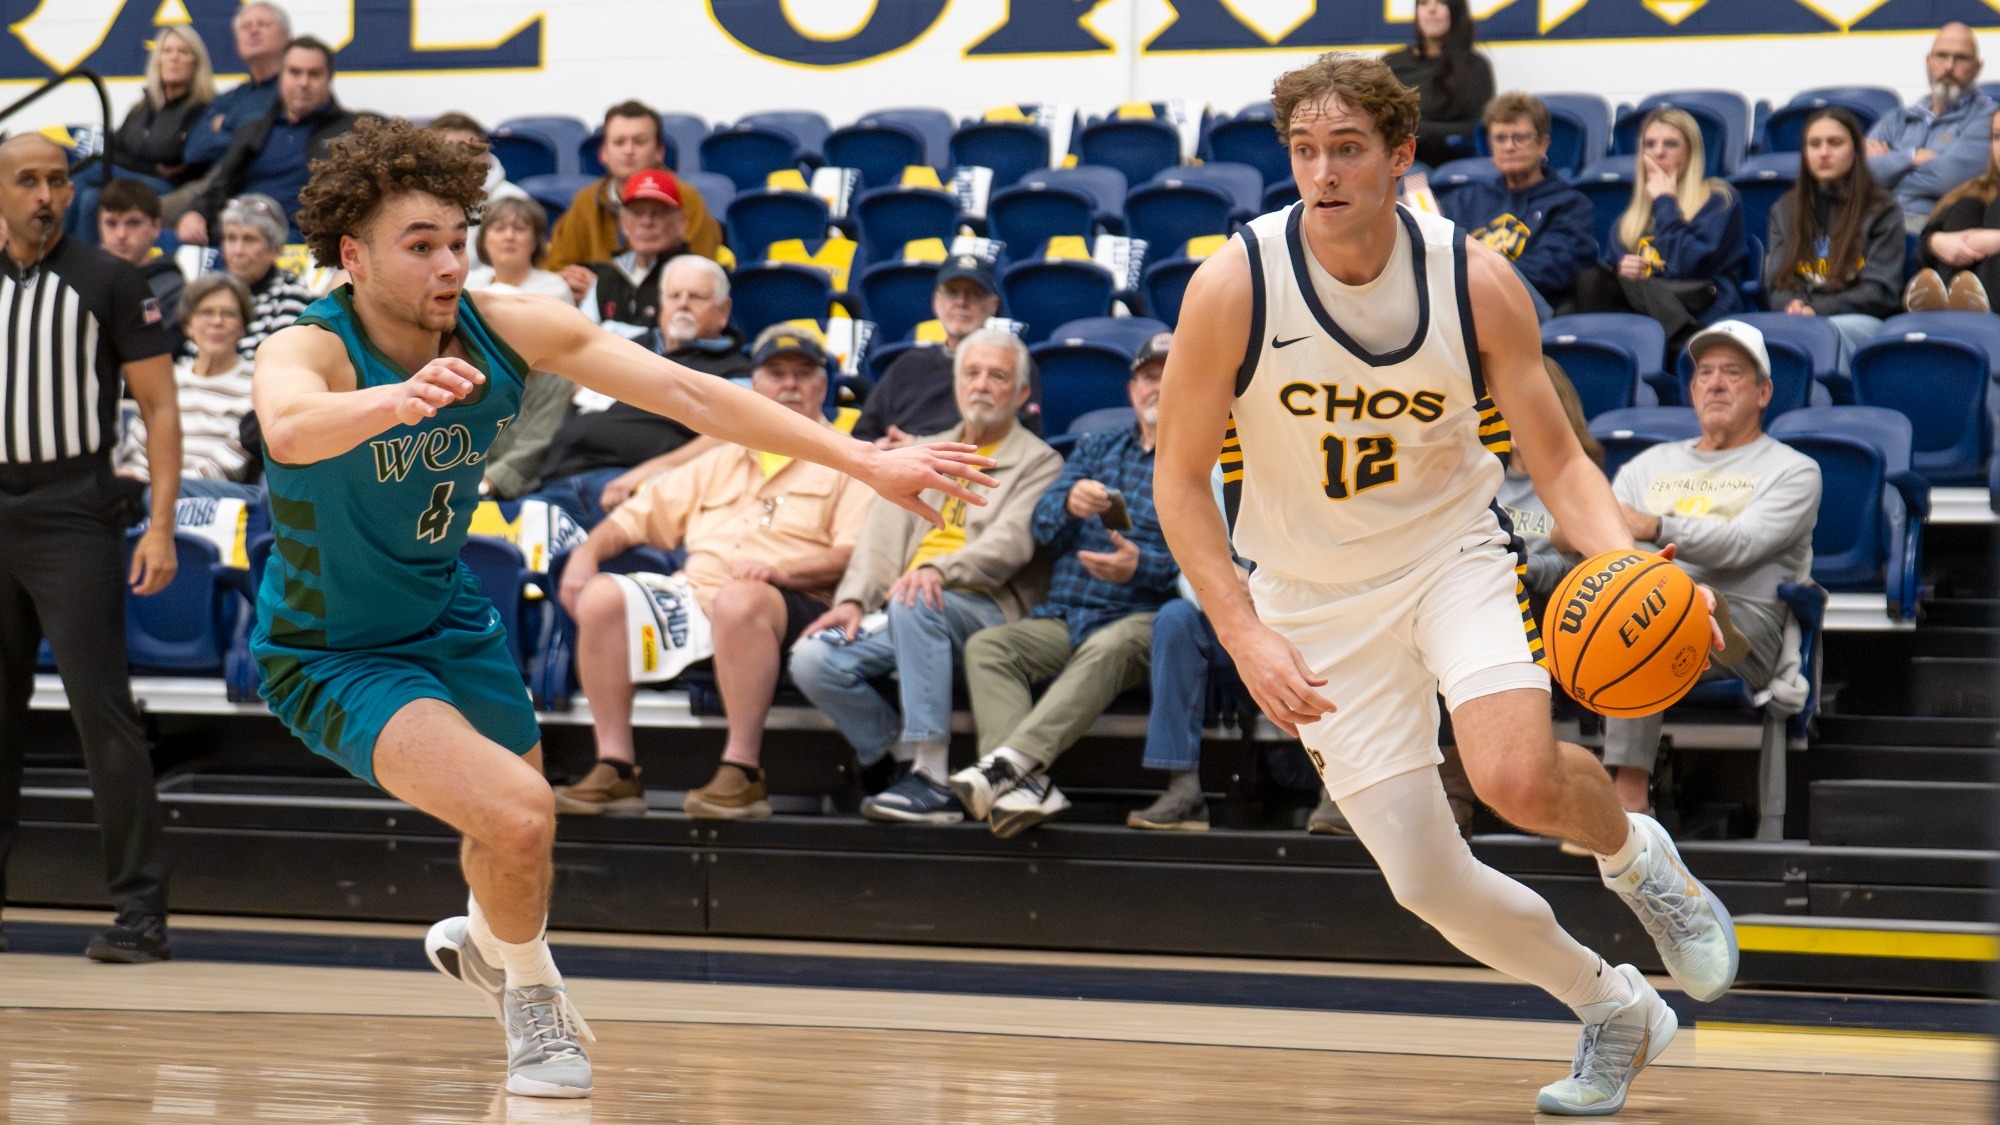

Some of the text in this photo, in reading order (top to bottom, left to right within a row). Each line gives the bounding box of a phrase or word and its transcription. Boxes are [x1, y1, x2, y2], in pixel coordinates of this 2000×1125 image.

[1278, 379, 1448, 424] CHOS
[1320, 432, 1399, 501] 12
[1651, 479, 1756, 492] CENTRAL OKLAHOMA
[417, 481, 455, 544] 4
[1559, 553, 1648, 635] Wilson
[1618, 587, 1667, 649] EVO
